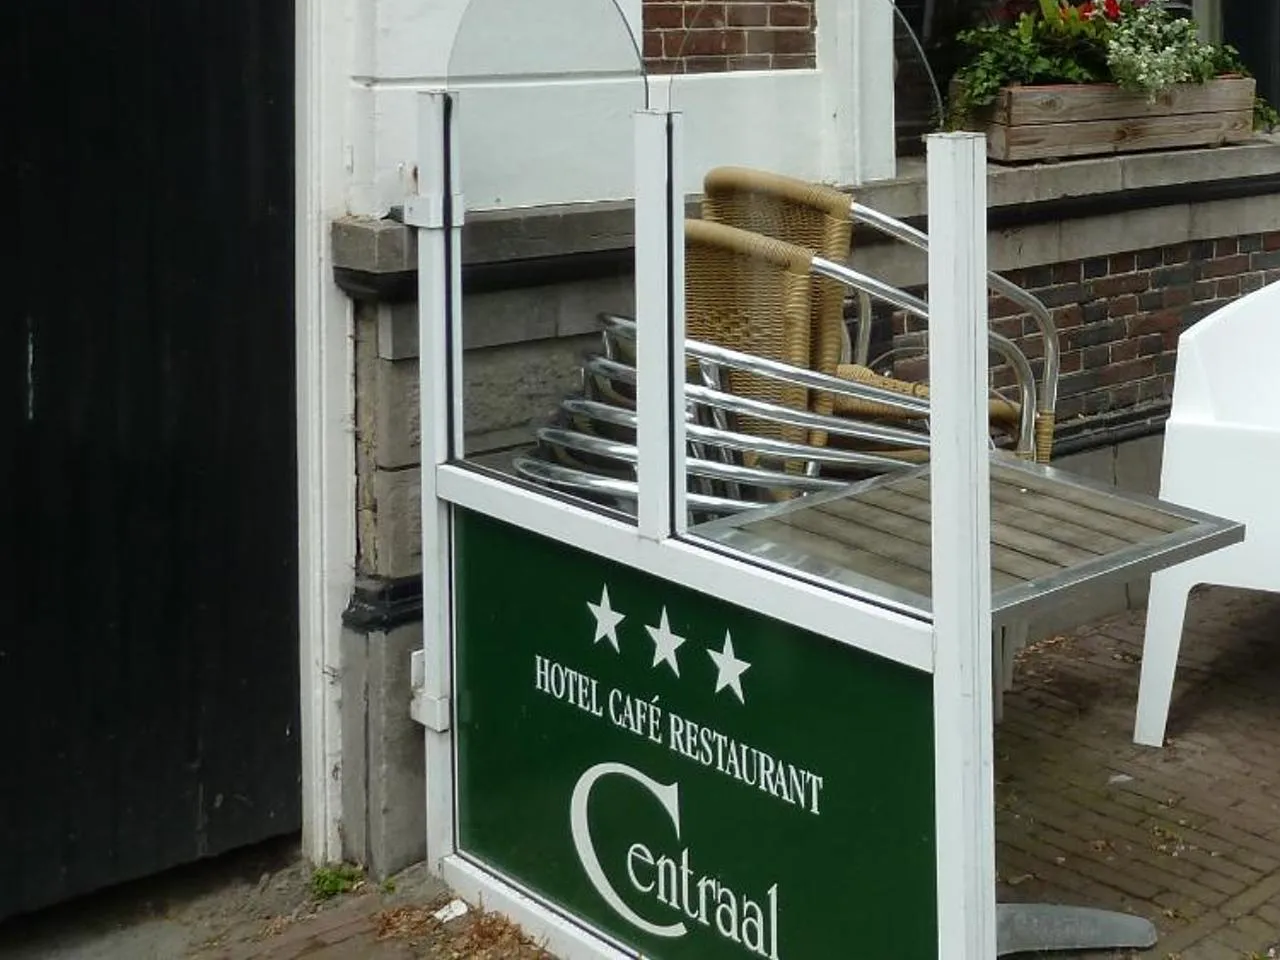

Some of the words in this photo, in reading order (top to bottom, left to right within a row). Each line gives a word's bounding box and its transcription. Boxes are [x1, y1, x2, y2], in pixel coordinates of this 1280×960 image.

[534, 655, 603, 717] HOTEL
[608, 688, 662, 744] CAFÉ
[668, 712, 824, 816] RESTAURANT
[570, 762, 779, 960] Centraal
